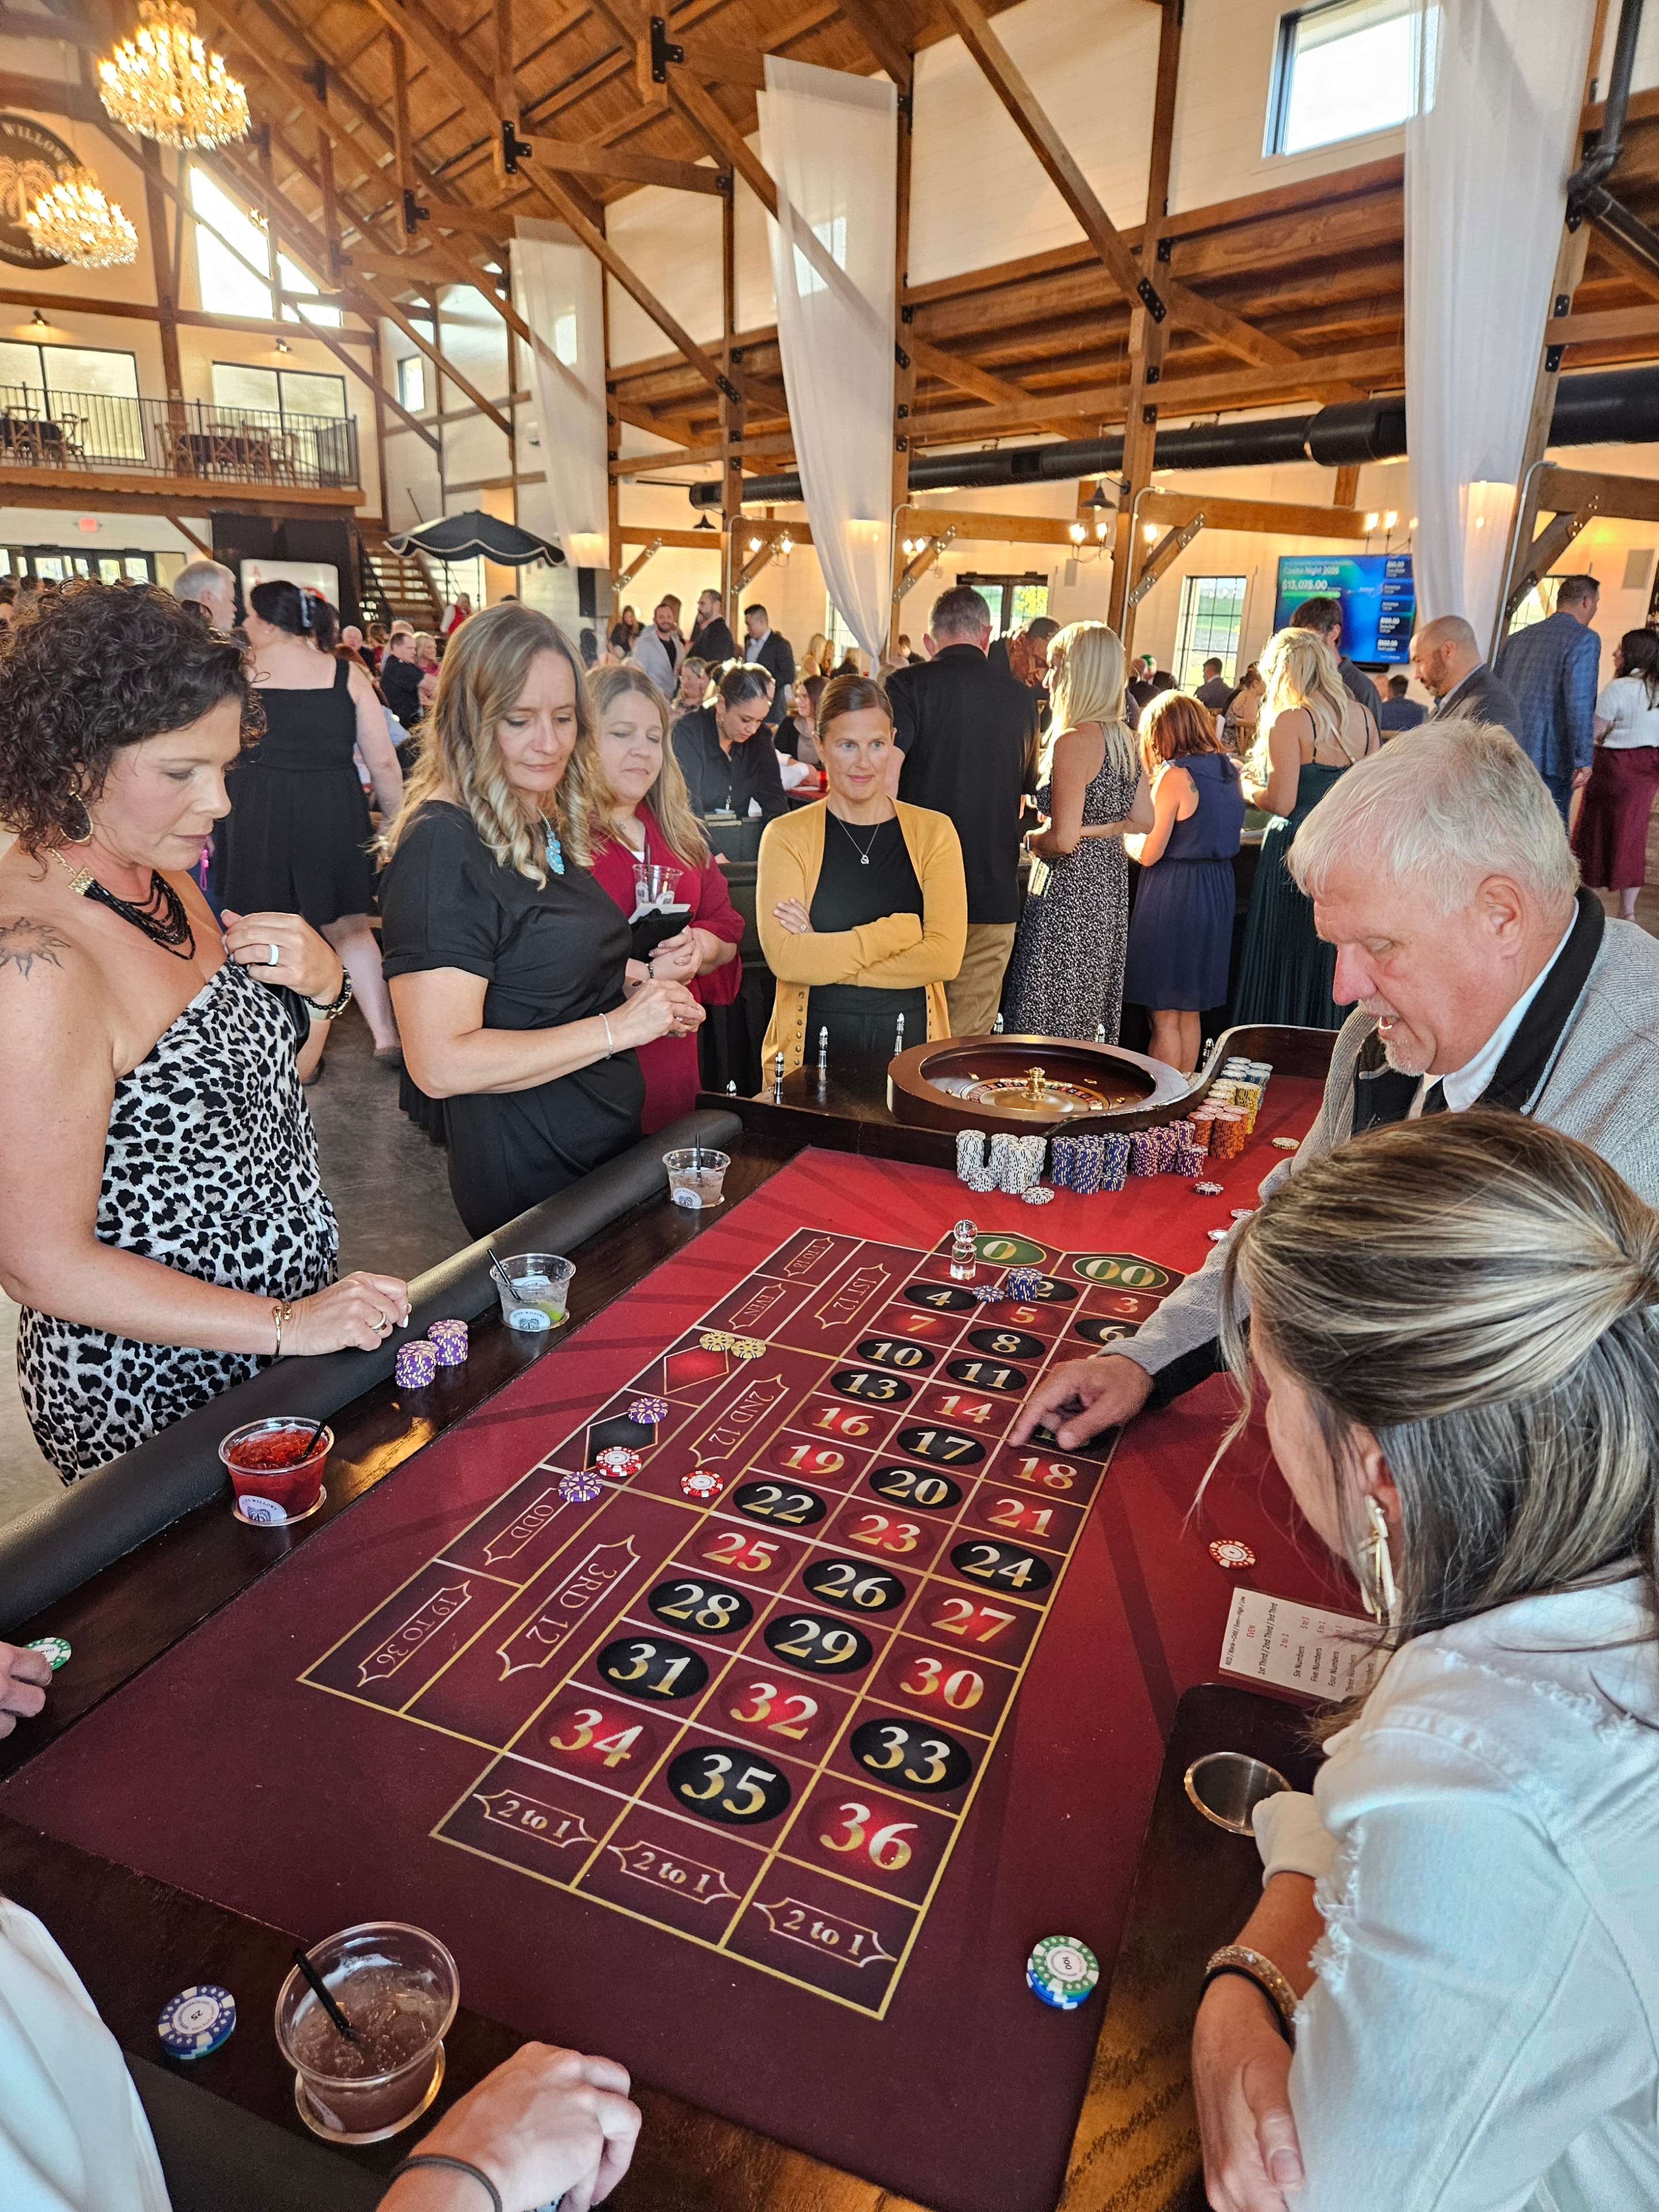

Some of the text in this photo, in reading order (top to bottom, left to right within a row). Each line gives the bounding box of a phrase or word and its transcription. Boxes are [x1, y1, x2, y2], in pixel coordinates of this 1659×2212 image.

[982, 1240, 1017, 1260] 0
[1086, 1259, 1155, 1286] 00
[833, 1277, 877, 1310] 1ST 12
[926, 1290, 953, 1306] 4
[1037, 1281, 1055, 1298] 2
[744, 1294, 774, 1317] EVEN
[1009, 1306, 1038, 1324] 5
[1113, 1297, 1139, 1313] 3
[906, 1314, 937, 1332] 7
[1100, 1326, 1127, 1341] 6
[866, 1342, 923, 1366] 10
[991, 1334, 1021, 1354] 8
[841, 1374, 899, 1399] 13
[959, 1363, 1011, 1389] 11
[707, 1390, 774, 1446] 2ND 12
[812, 1407, 874, 1436] 16
[933, 1395, 994, 1424] 14
[779, 1444, 845, 1475] 19
[908, 1431, 977, 1460] 17
[878, 1470, 948, 1505] 20
[1013, 1457, 1077, 1489] 18
[741, 1486, 814, 1524] 22
[987, 1498, 1054, 1537] 21
[510, 1504, 555, 1539] ODD
[849, 1514, 921, 1552] 23
[702, 1532, 781, 1572] 25
[961, 1545, 1035, 1588] 24
[812, 1564, 892, 1607] 26
[525, 1562, 618, 1645] 3RD 12
[656, 1584, 740, 1629] 28
[1269, 1602, 1278, 1613] Third
[376, 1595, 458, 1665] 19 TO 36
[930, 1597, 1017, 1643] 27
[1247, 1624, 1256, 1638] EVEN
[1264, 1624, 1273, 1639] Third
[774, 1619, 858, 1664] 29
[1263, 1637, 1271, 1649] 2nd
[608, 1643, 691, 1696] 31
[1259, 1653, 1268, 1669] Third
[1294, 1645, 1305, 1672] Numbers
[1312, 1647, 1323, 1671] Numbers
[1330, 1651, 1340, 1675] Numbers
[899, 1657, 984, 1710] 30
[1310, 1671, 1319, 1682] Five
[1328, 1675, 1337, 1687] Four
[1345, 1677, 1355, 1692] Three
[729, 1683, 819, 1740] 32
[549, 1709, 644, 1768] 34
[863, 1726, 951, 1784] 33
[680, 1753, 777, 1815] 35
[497, 1800, 571, 1839] 2 to 1
[819, 1802, 919, 1870] 36
[632, 1851, 711, 1894] 2 to 1
[782, 1909, 865, 1956] 2 to 1
[1062, 1956, 1073, 1970] 100
[191, 2009, 203, 2021] 25
